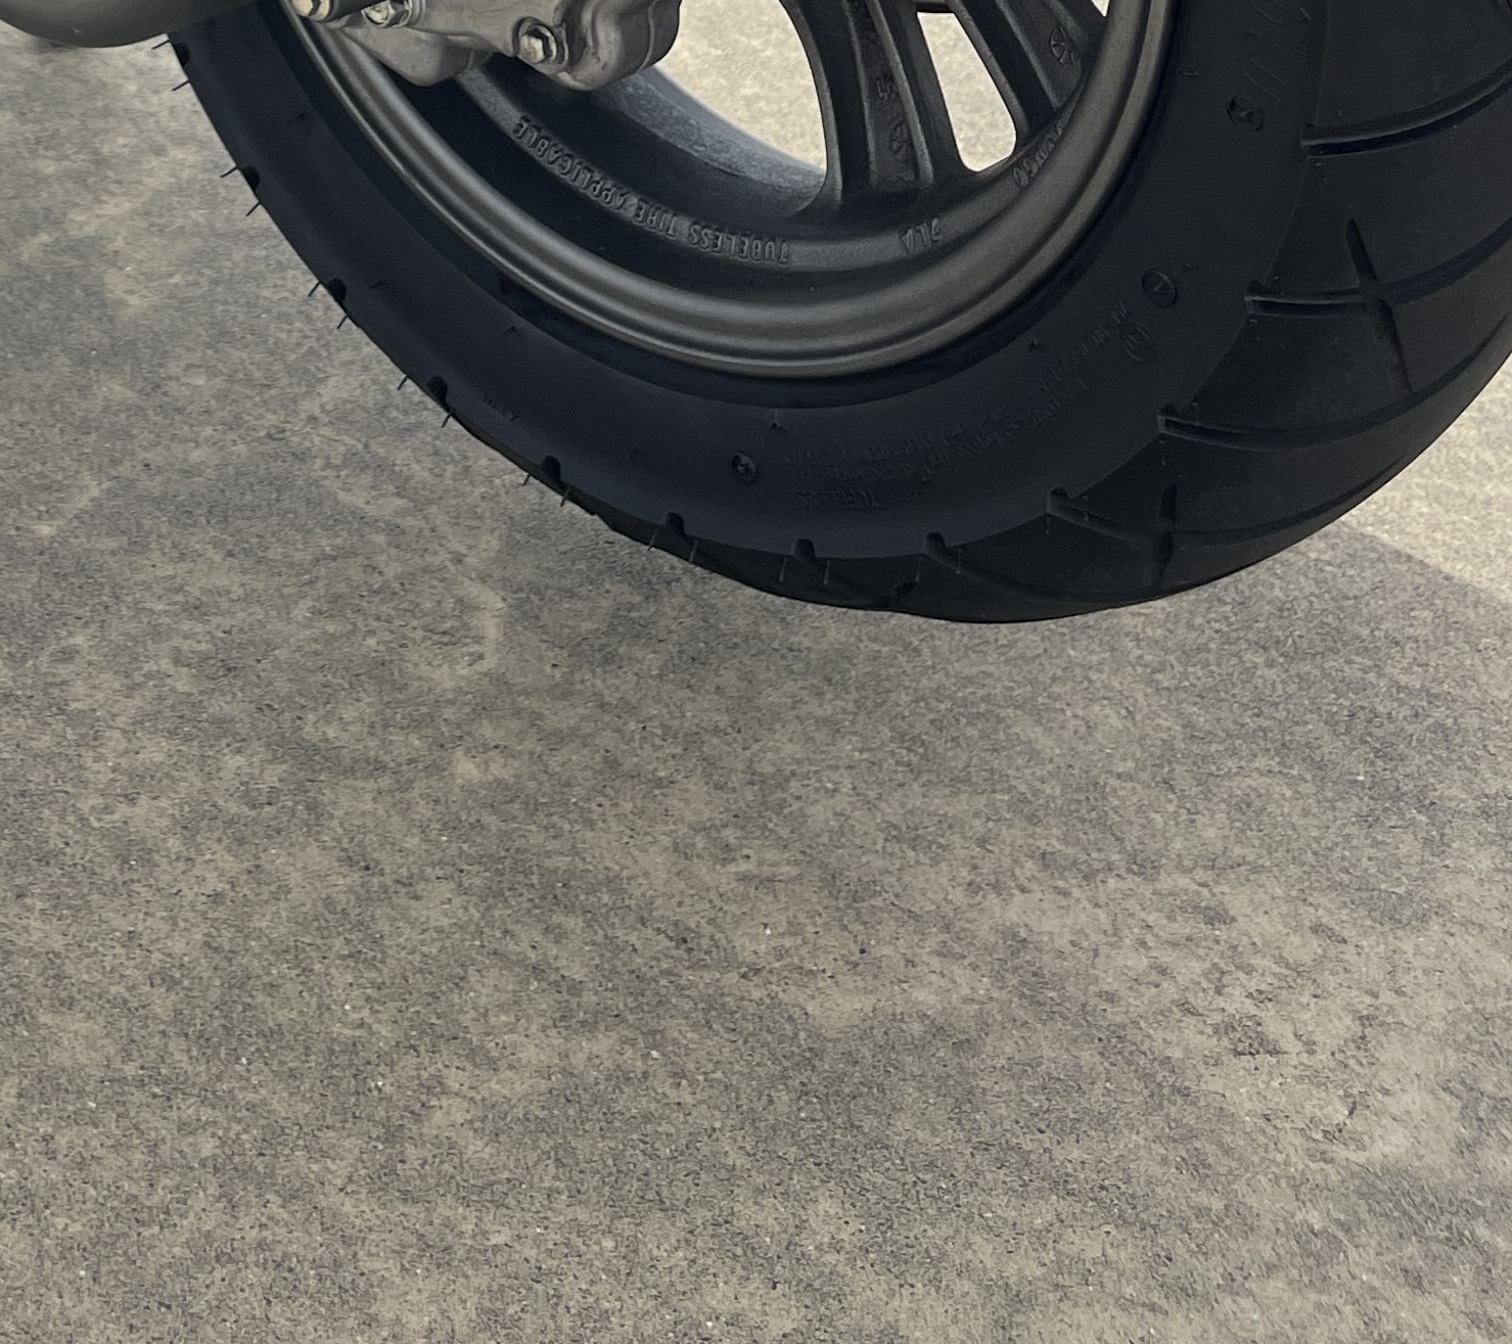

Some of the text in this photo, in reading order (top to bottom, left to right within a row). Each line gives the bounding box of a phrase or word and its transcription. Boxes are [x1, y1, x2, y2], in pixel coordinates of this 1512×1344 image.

[511, 115, 791, 267] TUBELESS TIRE APPLICABLE
